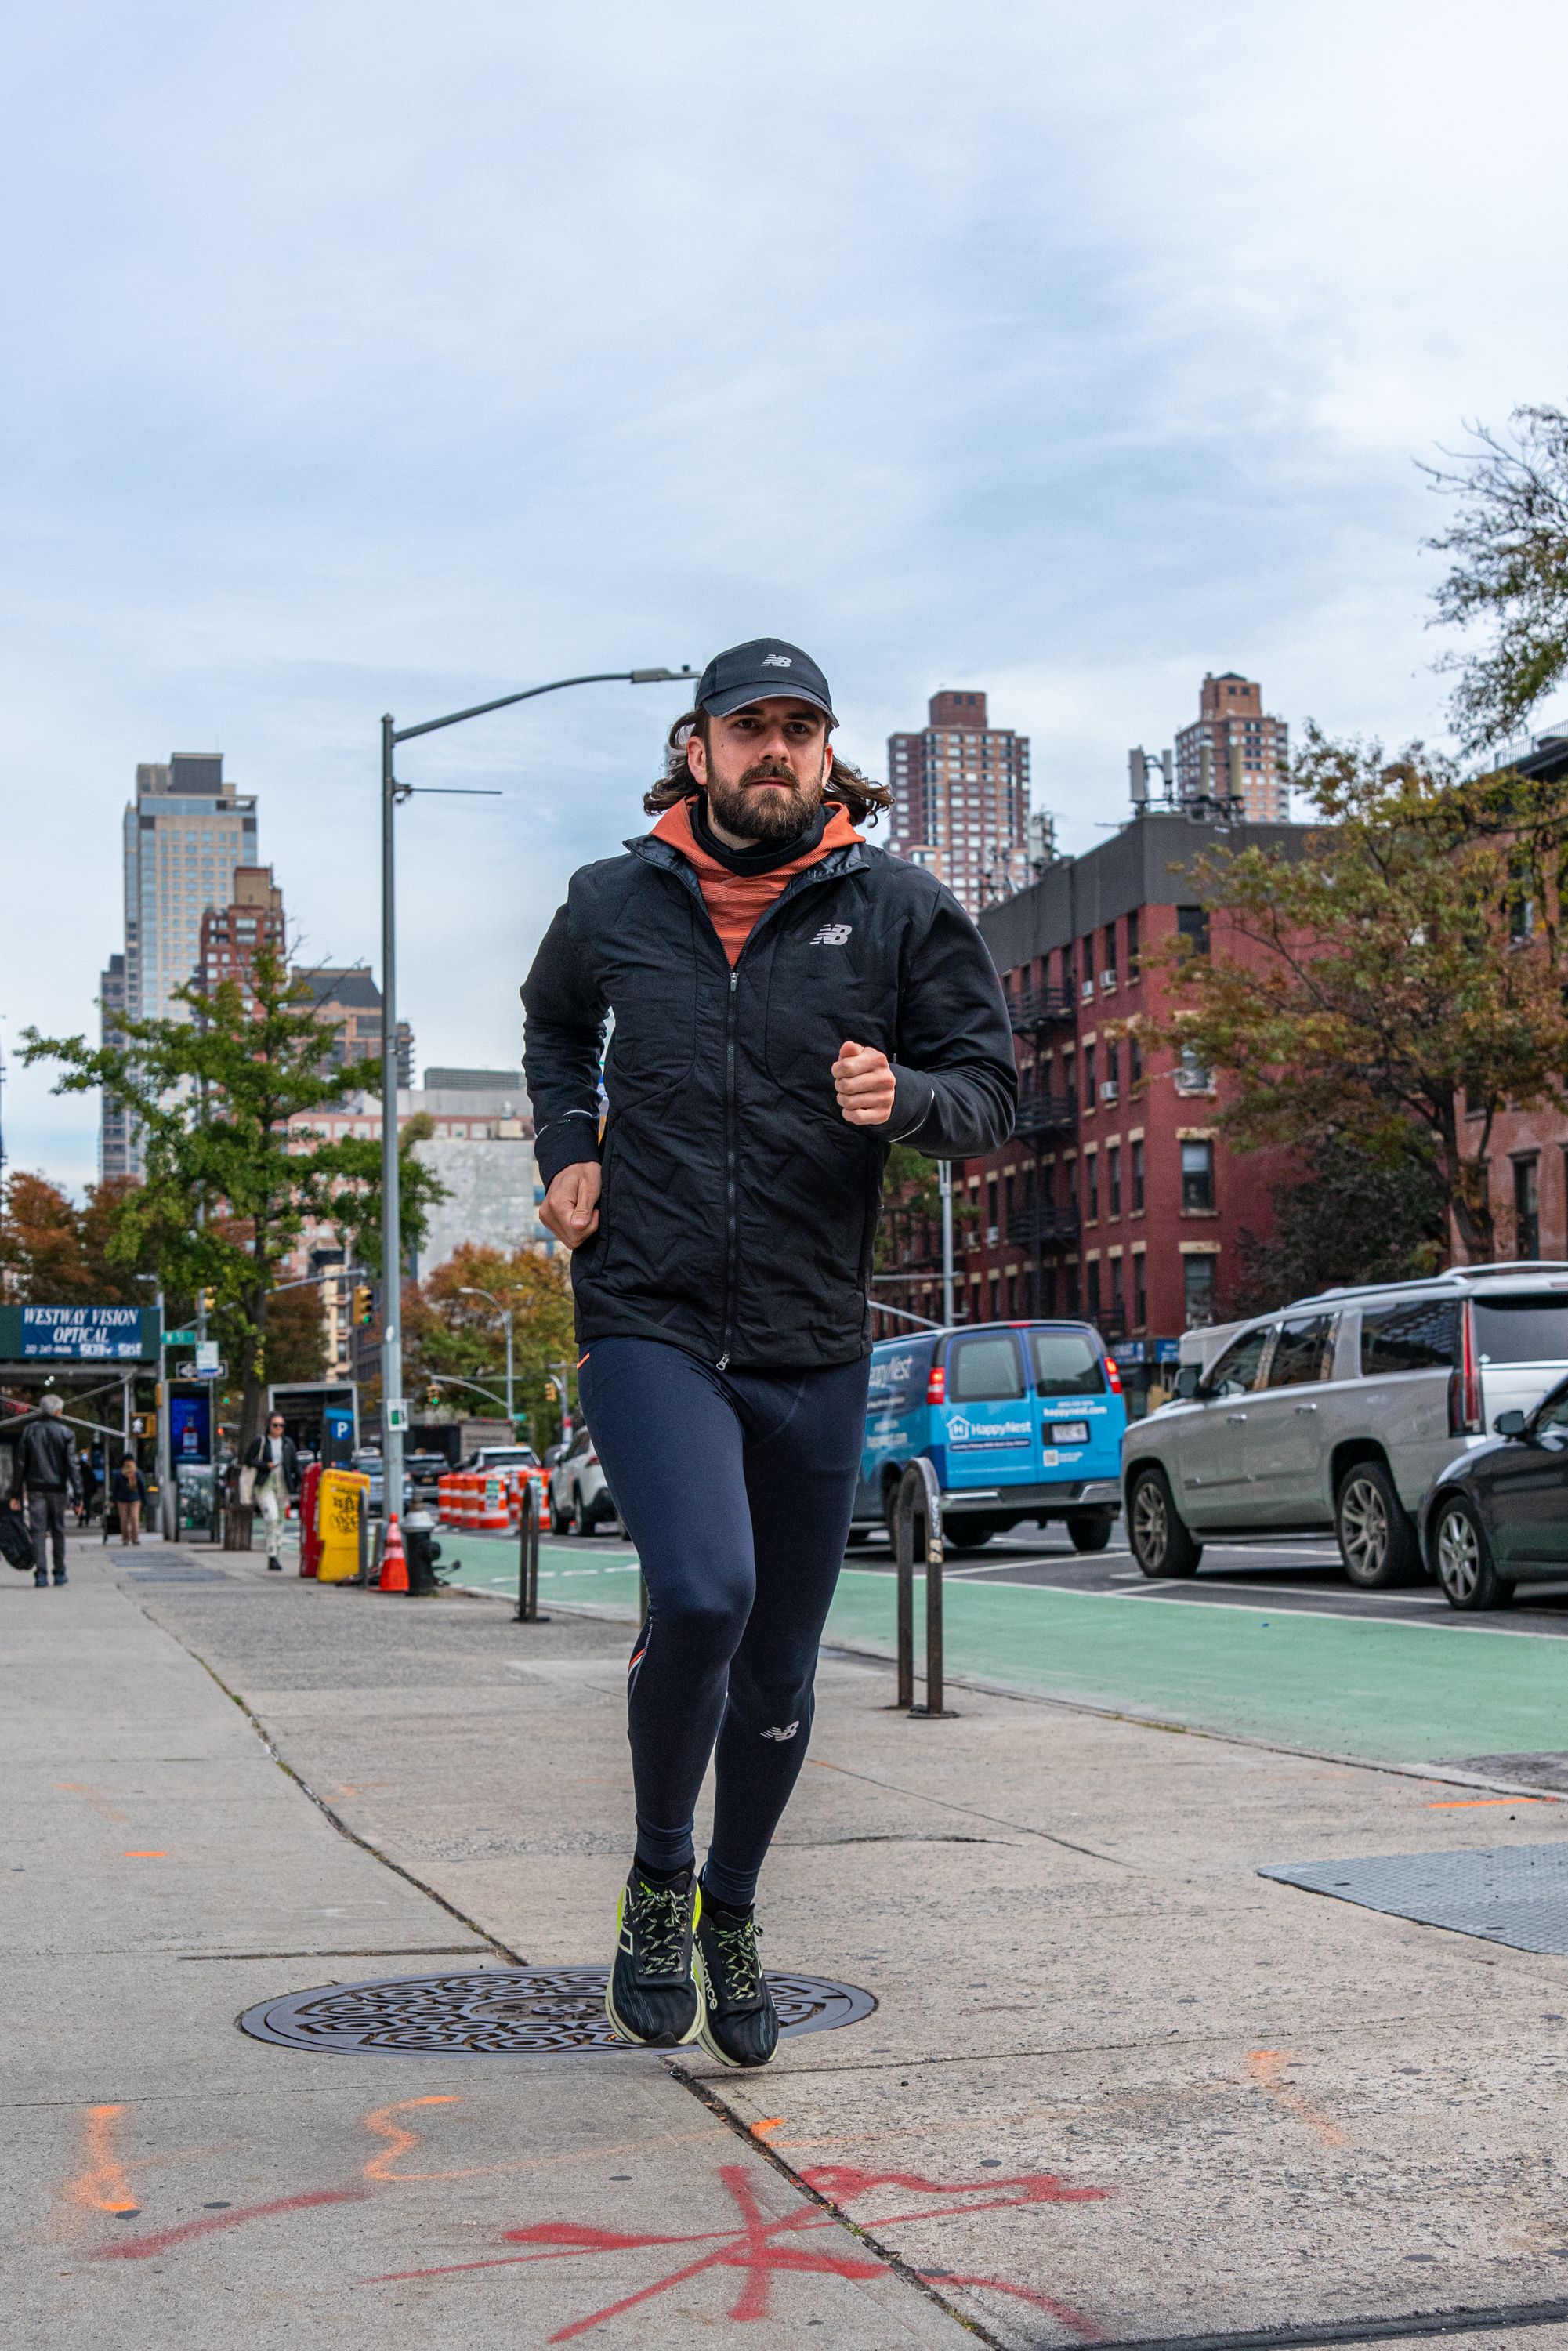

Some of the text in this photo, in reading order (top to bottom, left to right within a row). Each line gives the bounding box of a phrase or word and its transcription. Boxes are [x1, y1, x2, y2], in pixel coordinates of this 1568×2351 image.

[809, 923, 853, 946] NB
[24, 1307, 139, 1326] WESTWAY VISION
[53, 1326, 110, 1343] OPTICAL
[336, 1420, 349, 1439] P
[971, 1420, 1032, 1436] HappyNest
